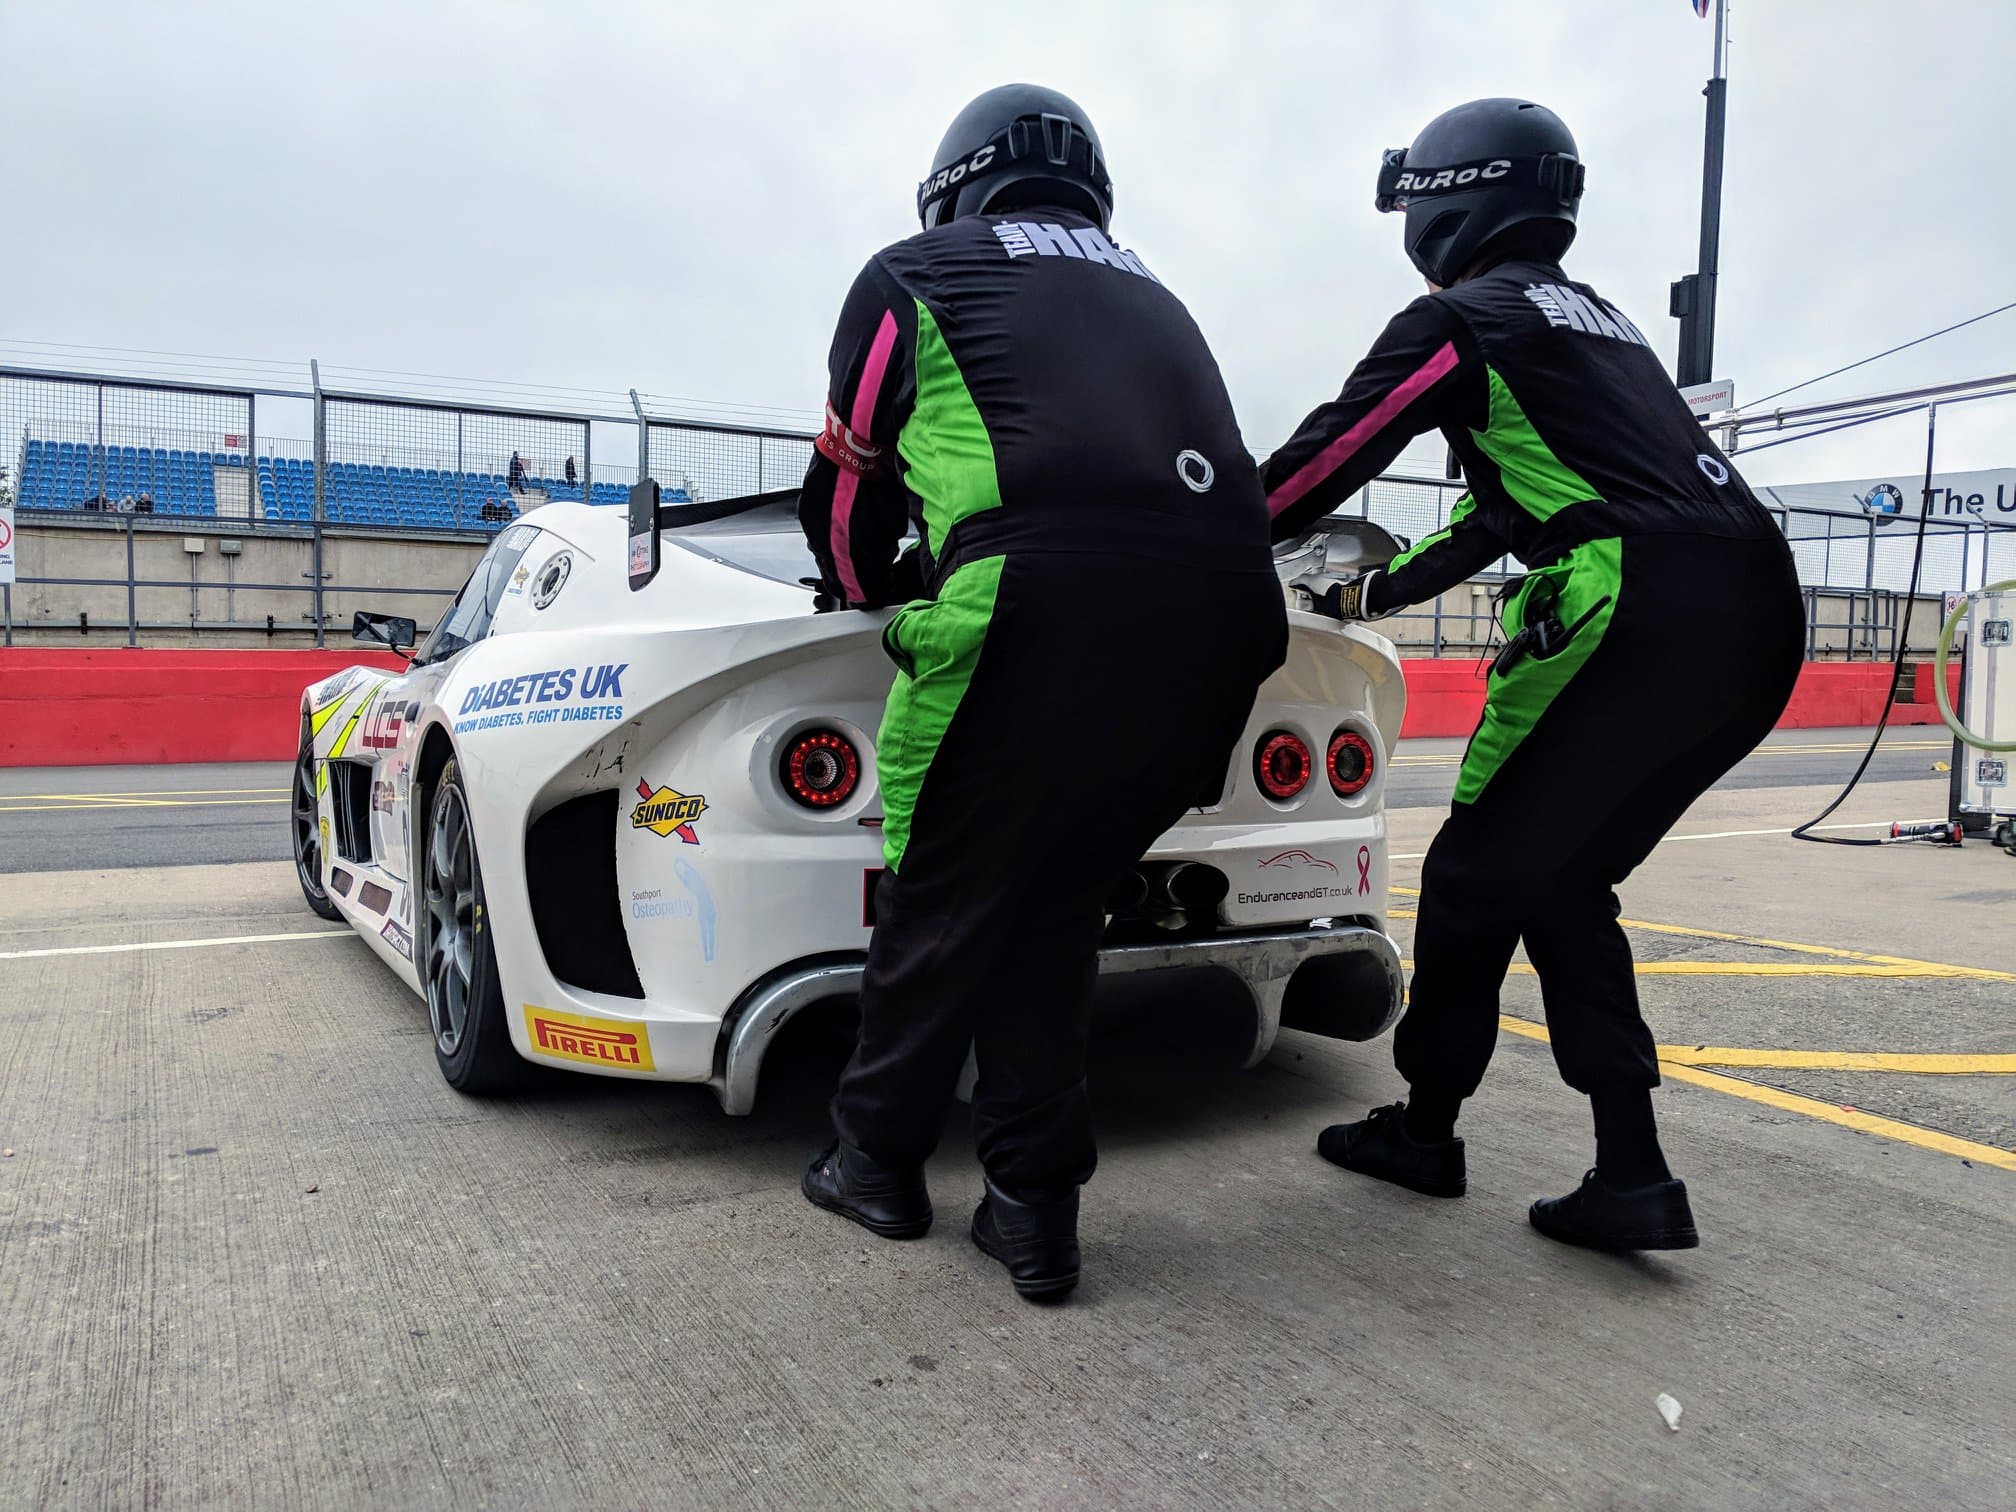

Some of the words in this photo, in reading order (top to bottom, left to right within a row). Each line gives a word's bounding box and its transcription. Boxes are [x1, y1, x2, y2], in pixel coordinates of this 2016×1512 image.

[1921, 487, 1985, 516] The
[580, 664, 630, 699] UK
[454, 718, 478, 735] KNOW
[526, 709, 560, 724] FIGHT
[561, 705, 623, 722] DIABETES
[635, 799, 701, 825] SUNOCO
[632, 888, 662, 902] Southport
[1238, 885, 1353, 904] EnduranceandGT.co.uk
[534, 1017, 641, 1065] PIRELLI
